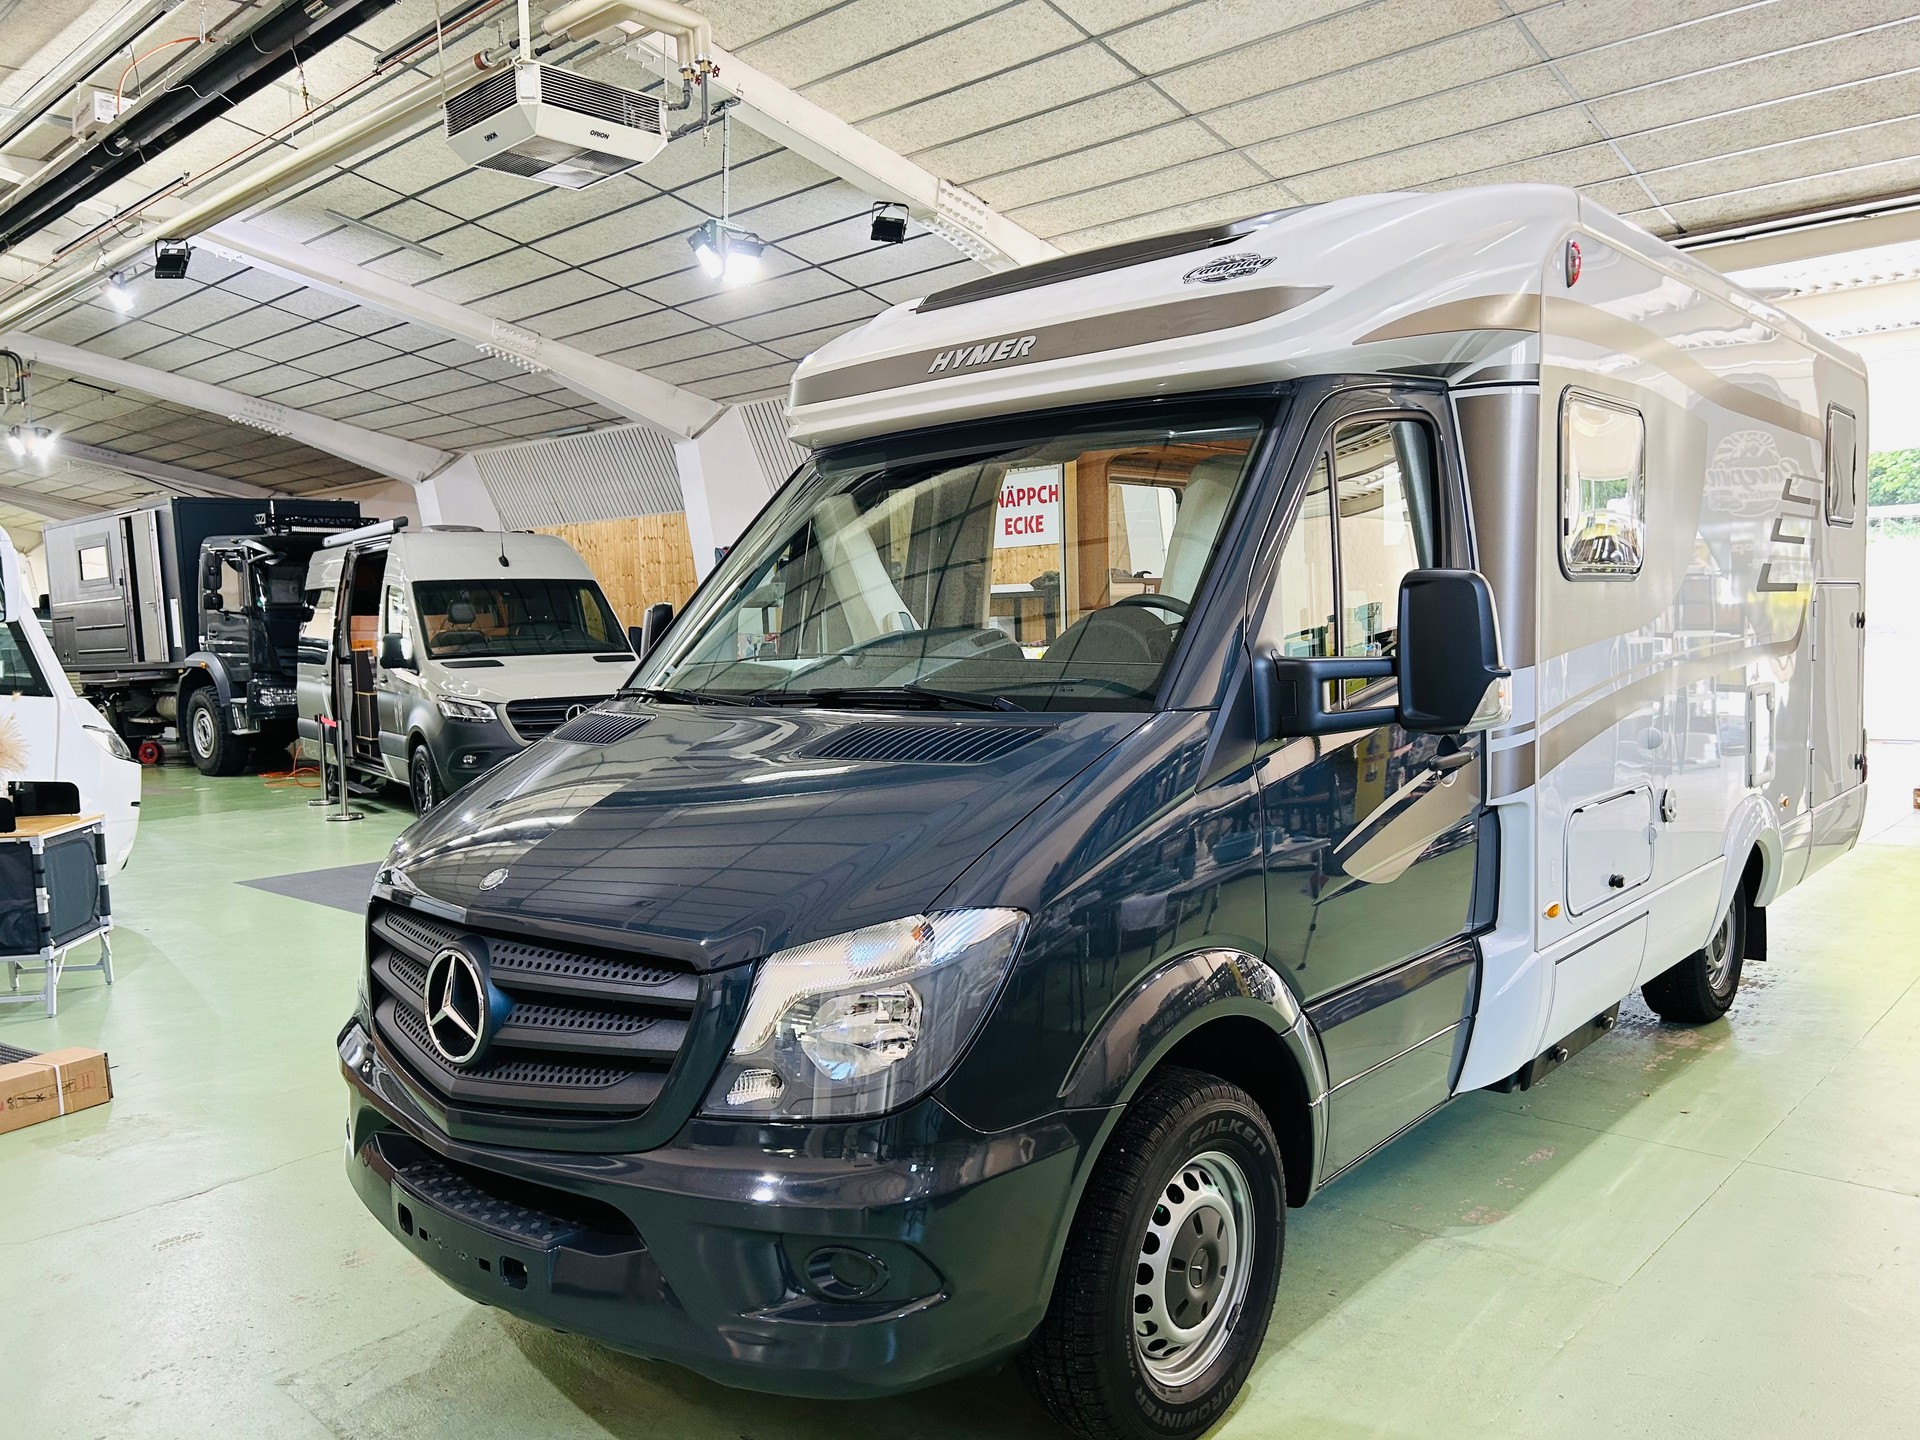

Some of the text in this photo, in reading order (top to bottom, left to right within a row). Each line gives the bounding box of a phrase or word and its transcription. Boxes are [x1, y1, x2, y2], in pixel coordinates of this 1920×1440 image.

[589, 129, 610, 140] ORION
[1183, 257, 1278, 281] Camping
[928, 335, 1037, 374] HYMER
[1005, 514, 1044, 536] ECKE
[1186, 1118, 1268, 1157] FALKEN
